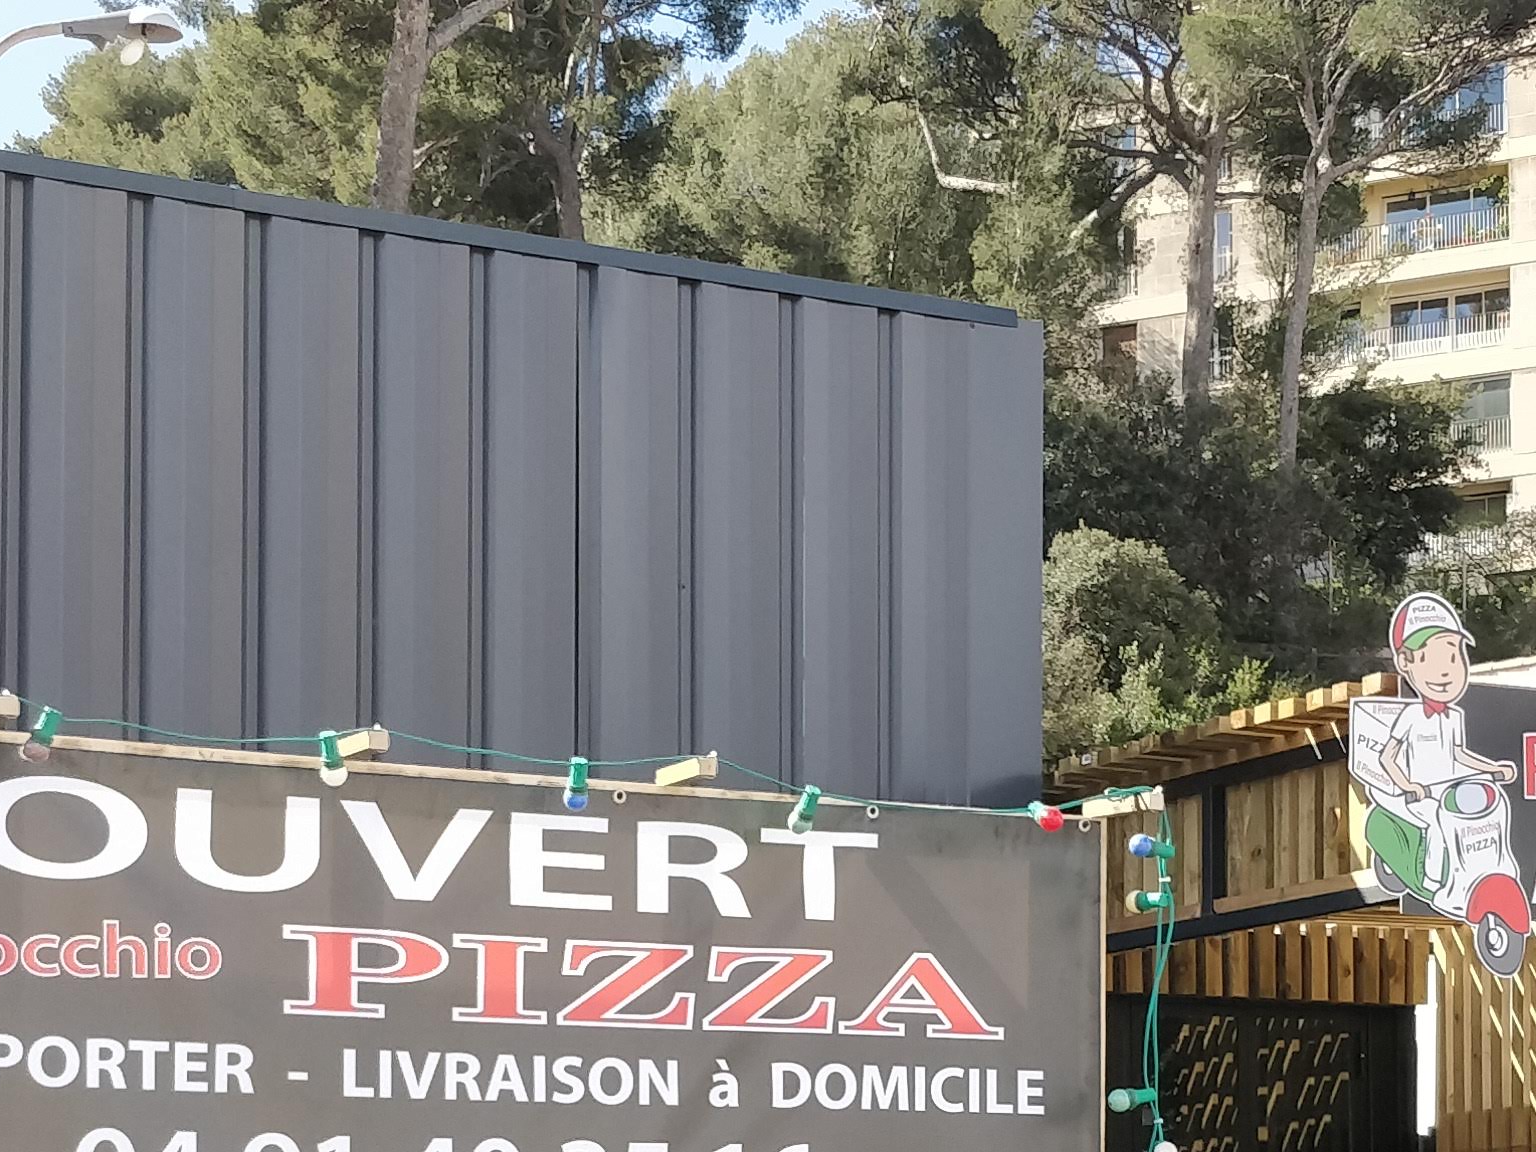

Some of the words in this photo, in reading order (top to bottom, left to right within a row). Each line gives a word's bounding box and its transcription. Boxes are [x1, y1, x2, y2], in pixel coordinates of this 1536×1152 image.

[1466, 836, 1497, 854] PIZZA
[282, 923, 1005, 1041] PIZZA
[288, 1071, 308, 1081] -
[342, 1048, 679, 1106] LIVRAISON
[709, 1058, 740, 1108] à
[771, 1061, 1046, 1114] DOMICILE
